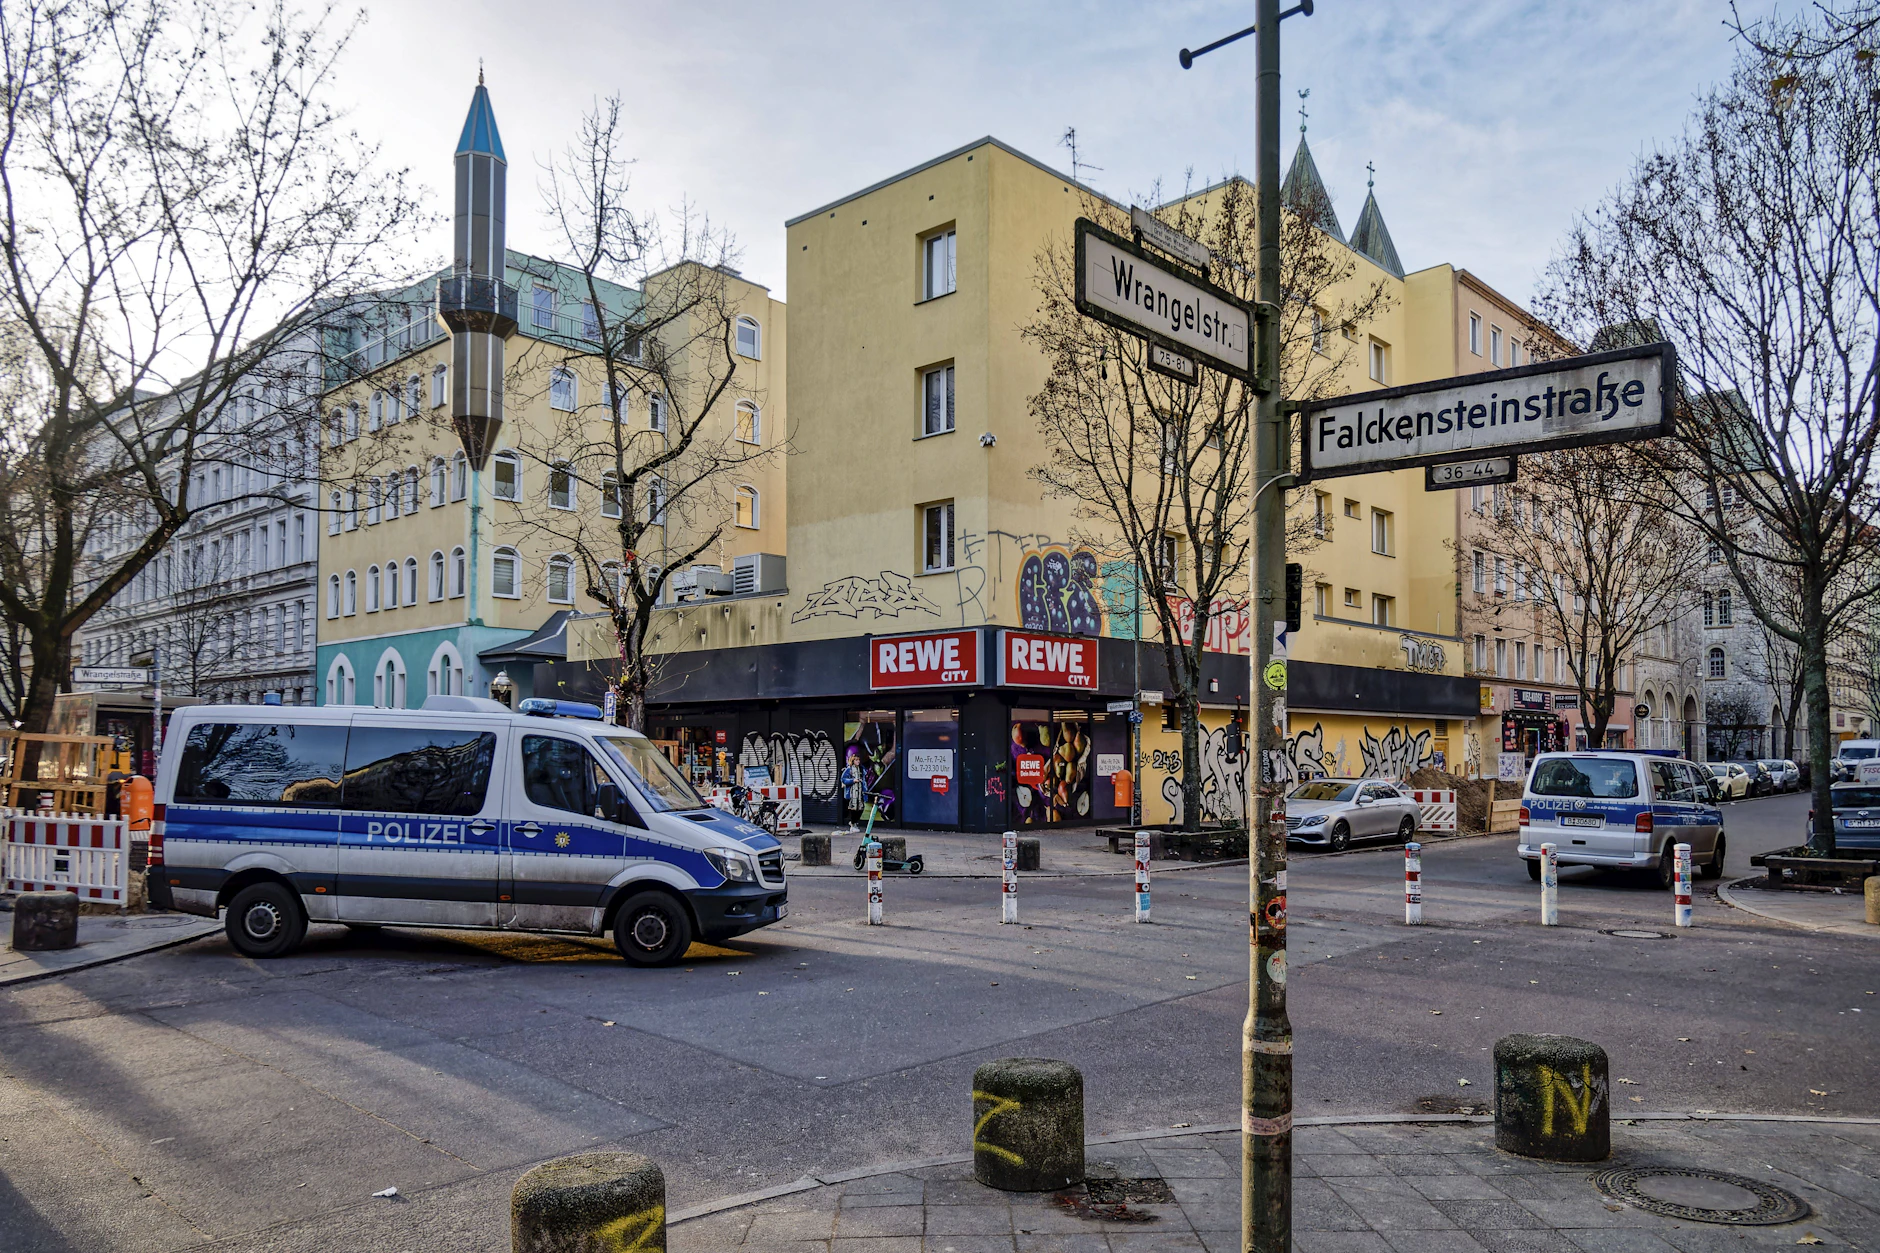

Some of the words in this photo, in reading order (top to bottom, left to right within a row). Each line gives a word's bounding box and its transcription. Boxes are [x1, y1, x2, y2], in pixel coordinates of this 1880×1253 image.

[1111, 255, 1233, 348] Wrangelstr.
[1158, 349, 1188, 374] 75-81
[1317, 371, 1645, 453] Falckensteinstraße
[1442, 461, 1496, 482] 36-44
[879, 637, 960, 674] REWE
[1011, 637, 1084, 674] REWE
[81, 669, 142, 680] Wrangelstraße
[941, 670, 969, 682] CITY
[1068, 674, 1090, 686] CITY
[934, 755, 946, 763] 7-24
[1020, 760, 1040, 769] REWE
[1152, 749, 1182, 774] 243
[1530, 800, 1573, 811] POLIZEI
[367, 821, 466, 845] POLIZEI
